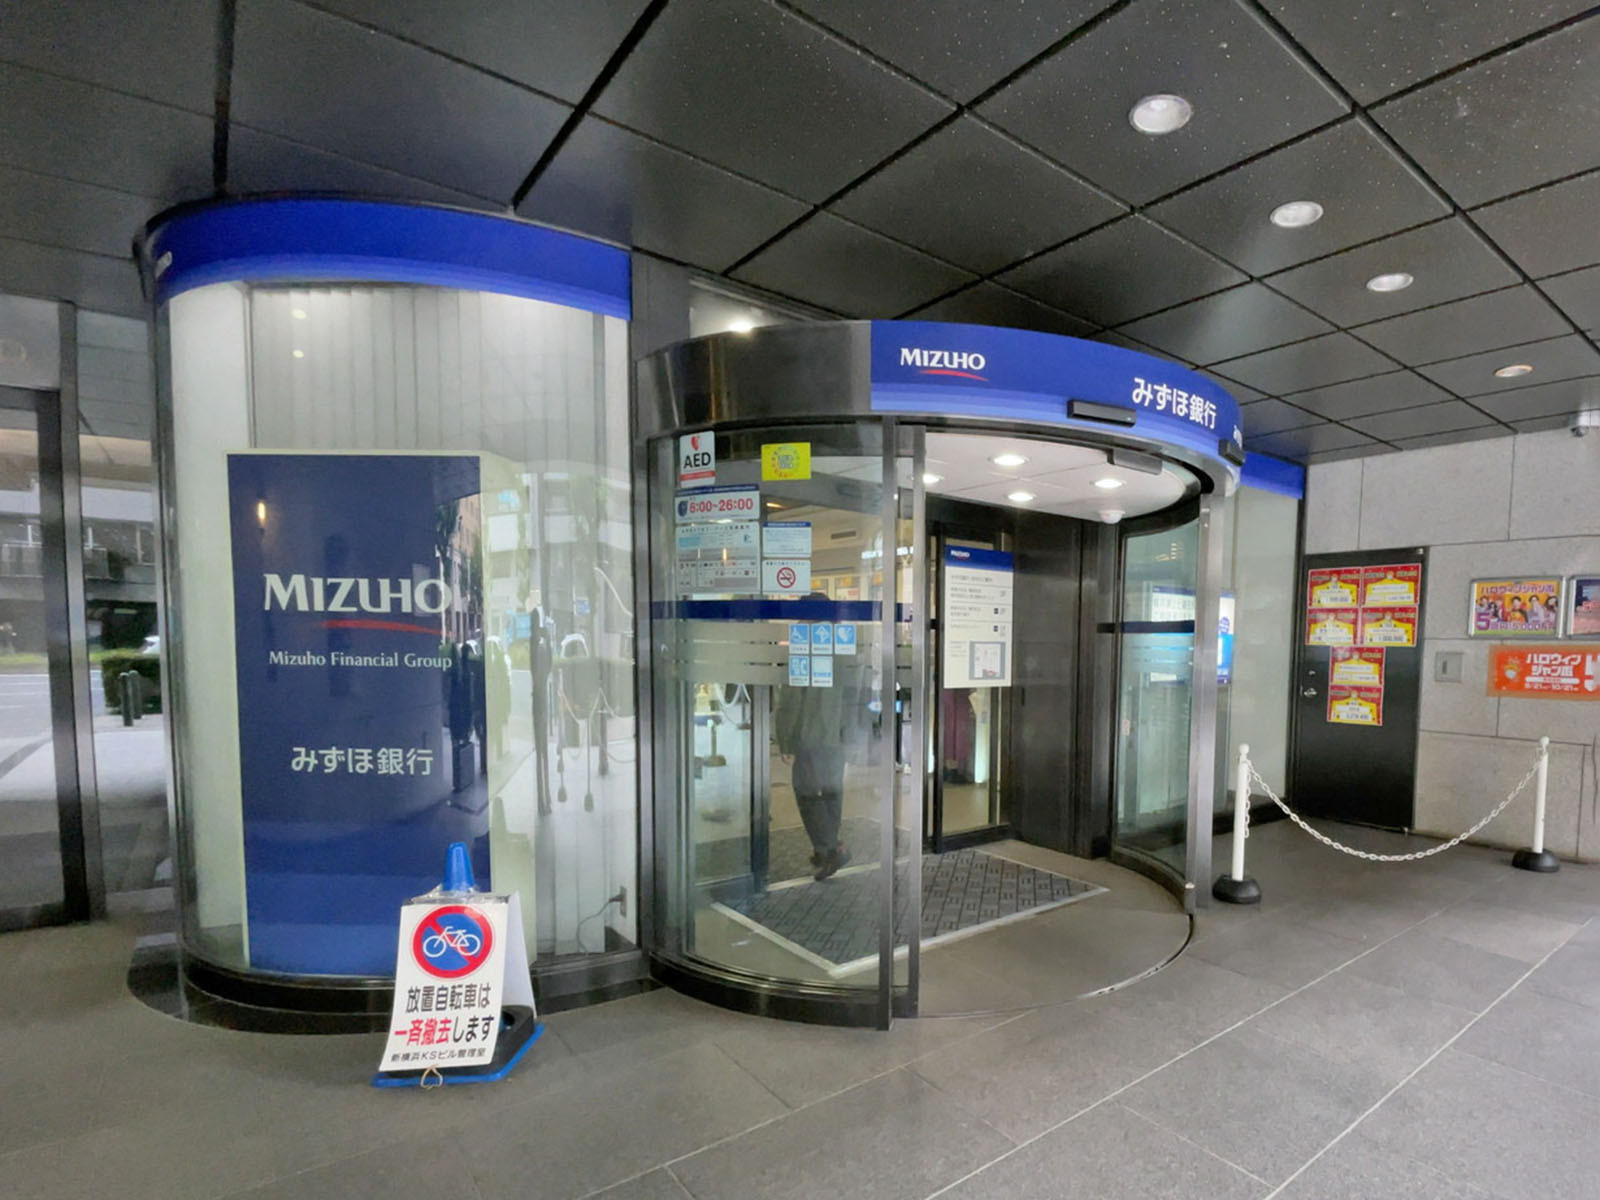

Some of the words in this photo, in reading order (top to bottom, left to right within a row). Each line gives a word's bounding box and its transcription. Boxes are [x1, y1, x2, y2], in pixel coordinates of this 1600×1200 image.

[900, 347, 987, 371] MIZUHO
[1132, 377, 1217, 430] みずほ銀行
[683, 451, 712, 469] AED
[263, 573, 453, 614] MIZUHO
[268, 651, 327, 667] Mizuho
[331, 651, 399, 667] Financial
[404, 652, 453, 671] Group
[1526, 653, 1583, 666] ハロウィン
[291, 746, 434, 776] みずほ銀行
[405, 982, 492, 1013] 放置自転車は
[394, 1014, 495, 1046] 一斉撤去します
